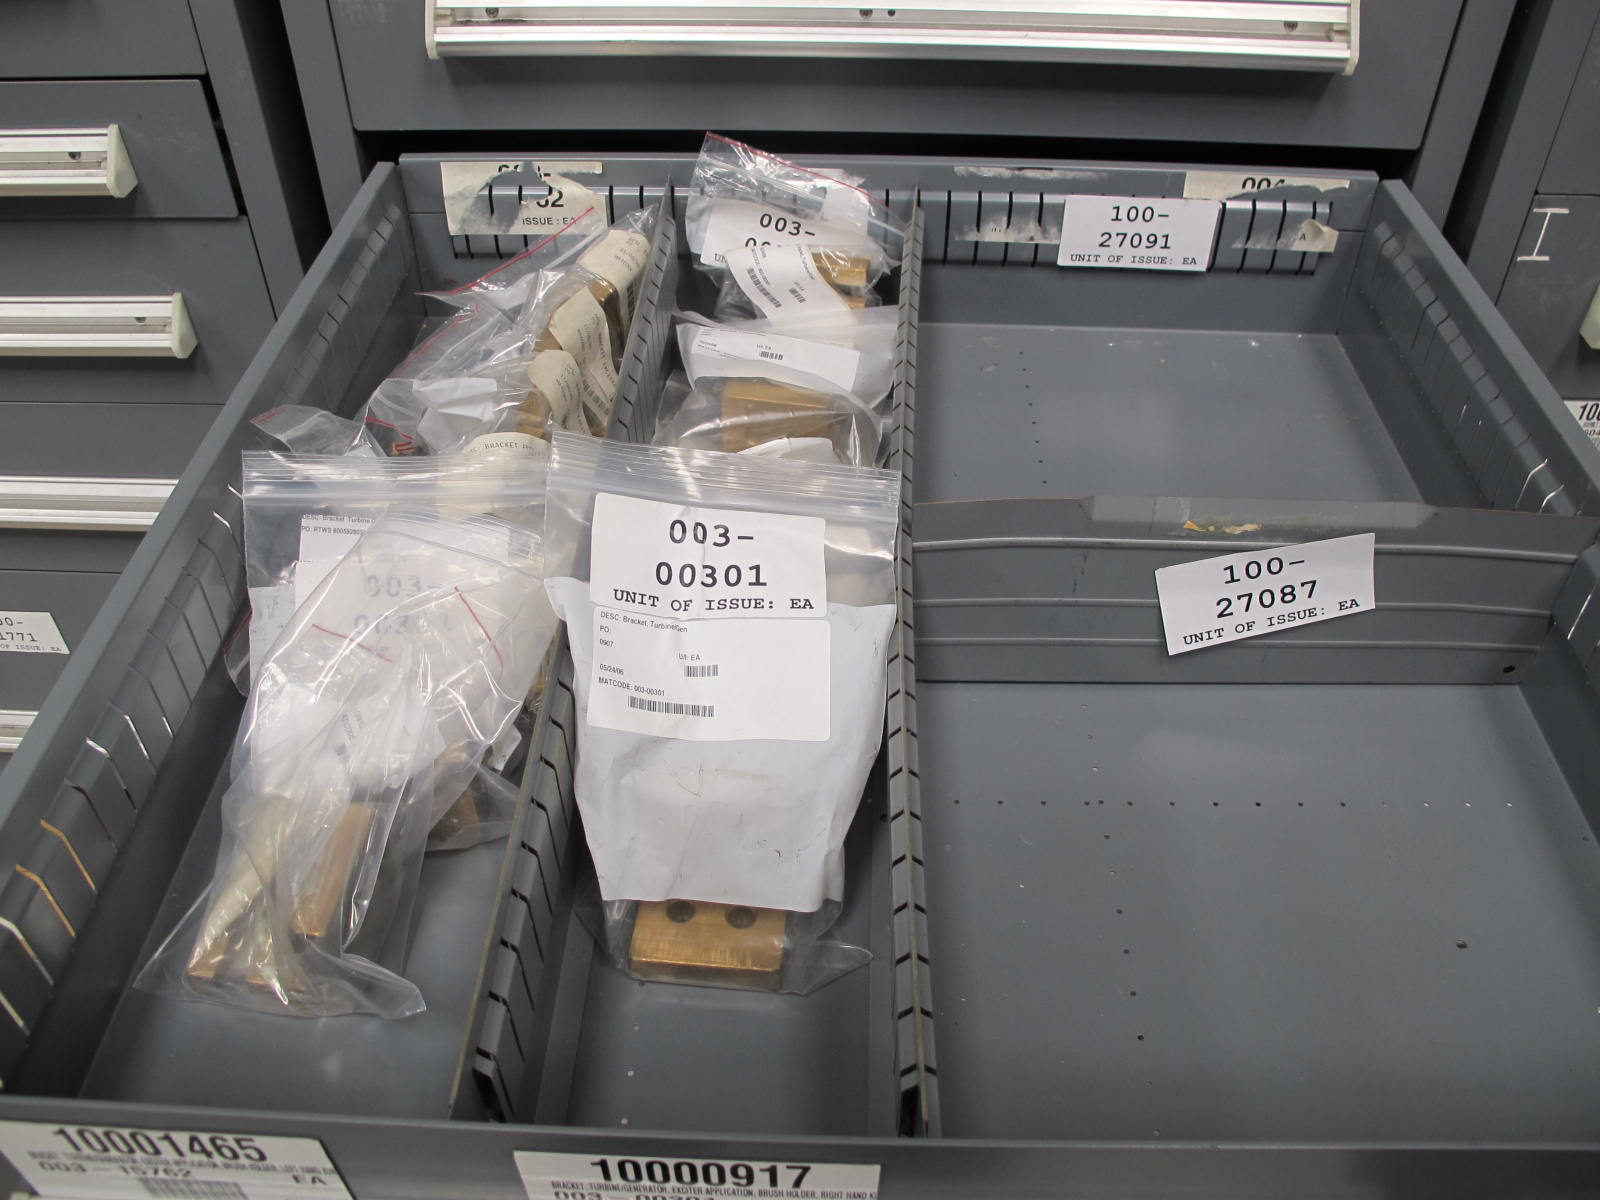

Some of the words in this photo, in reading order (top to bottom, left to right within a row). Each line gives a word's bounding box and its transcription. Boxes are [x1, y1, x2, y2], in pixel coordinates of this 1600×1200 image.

[760, 213, 815, 236] 003-
[1111, 205, 1170, 223] 100-
[1098, 232, 1172, 249] 27091
[1070, 254, 1101, 262] UNIT
[1107, 255, 1124, 263] OF
[1130, 256, 1174, 265] ISSUE:
[1182, 257, 1198, 265] EA
[669, 519, 754, 547] 003-
[655, 561, 768, 588] 00301
[1223, 556, 1306, 585] 100-
[613, 588, 660, 608] UNIT
[670, 599, 693, 612] OF
[705, 599, 774, 610] ISSUE:
[789, 599, 815, 610] EA
[1215, 580, 1318, 619] 27087
[600, 611, 621, 622] DESC:
[1183, 627, 1225, 646] UNIT
[1235, 620, 1257, 634] OF
[1266, 606, 1327, 627] ISSUE:
[1338, 598, 1361, 612] EA
[598, 676, 633, 691] MATCODE:
[633, 685, 666, 698] 003-00301
[53, 1128, 267, 1162] 10001465
[590, 1158, 811, 1189] 10000917
[758, 1189, 784, 1198] BRUSH
[820, 1191, 843, 1199] RIGHT
[846, 1191, 868, 1200] HAND
